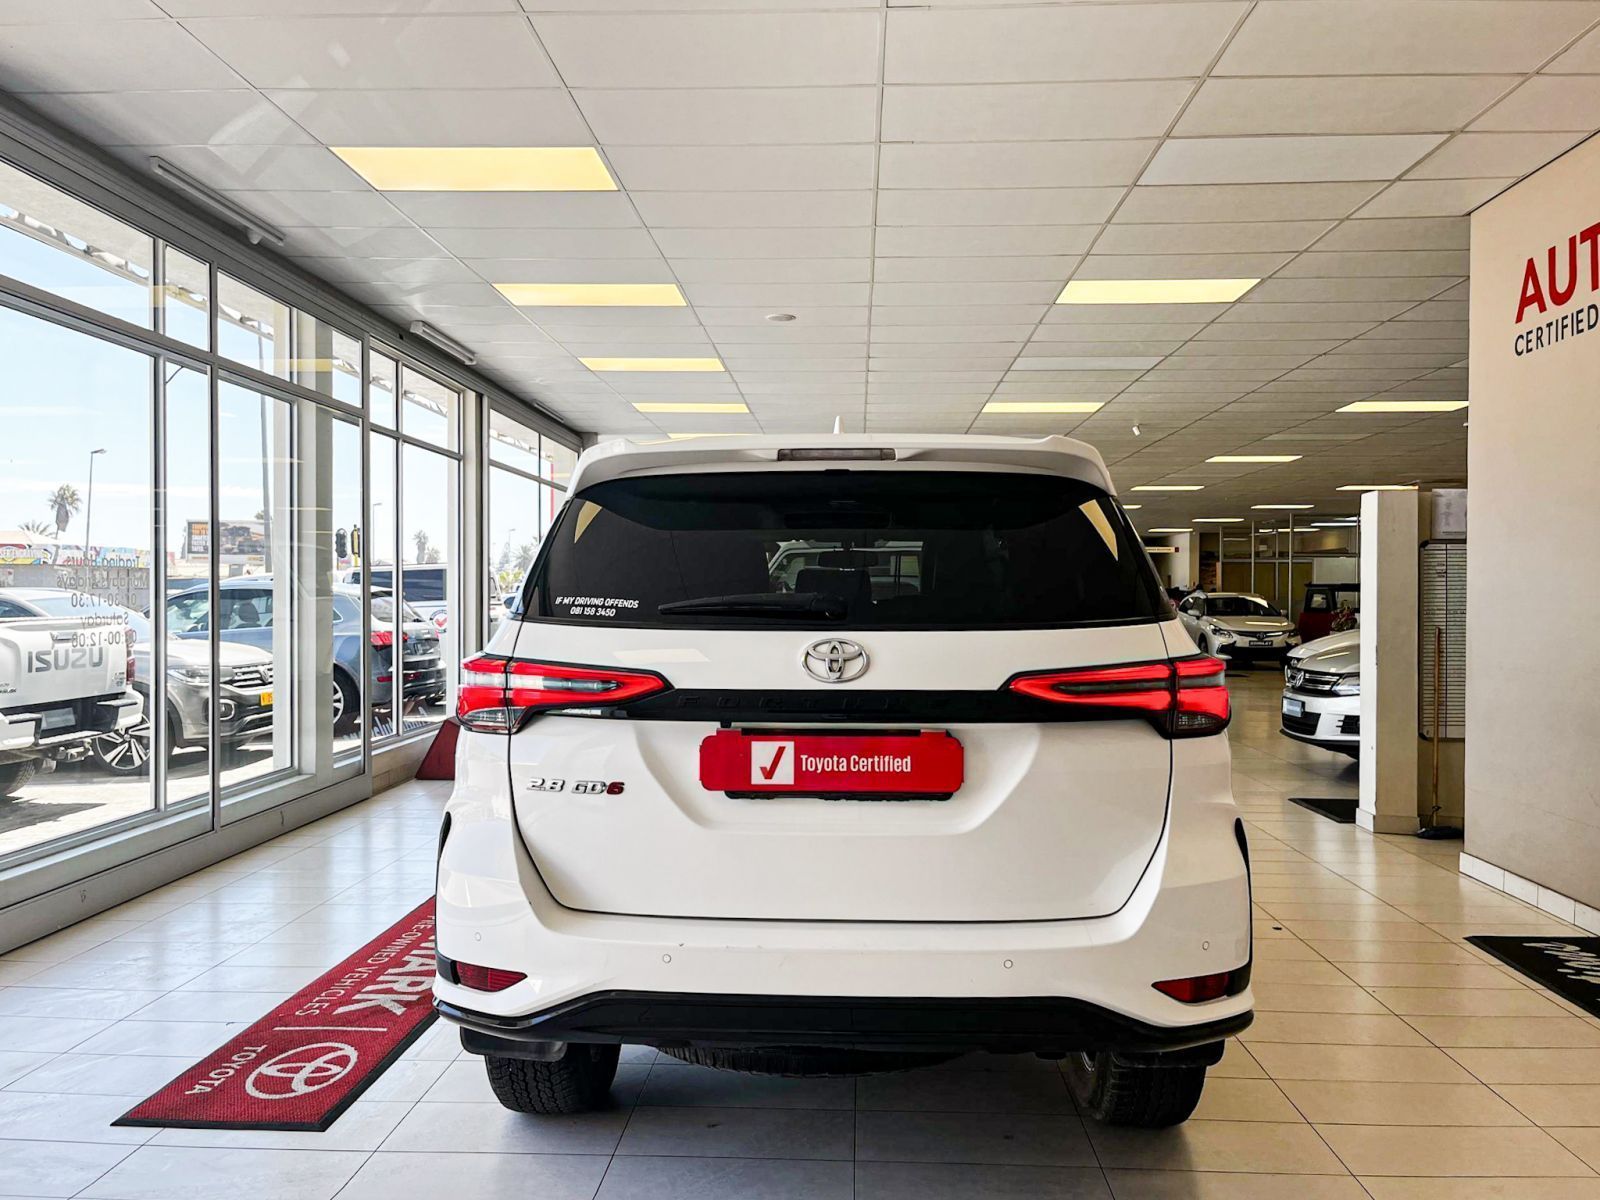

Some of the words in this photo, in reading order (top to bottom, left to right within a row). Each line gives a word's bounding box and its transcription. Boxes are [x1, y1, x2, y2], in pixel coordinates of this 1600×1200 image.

[1515, 222, 1600, 324] AUT
[1514, 303, 1599, 356] CERTIFIED
[570, 606, 583, 614] 081
[583, 607, 596, 615] 158
[596, 607, 616, 616] 3450
[574, 597, 604, 606] DRIVING
[604, 598, 639, 608] OFFENDS
[27, 647, 104, 674] ISUZU
[800, 754, 847, 773] Toyota
[850, 754, 912, 773] Certified
[294, 966, 381, 1017] VEHICLES
[184, 1043, 268, 1096] TOYOTA
